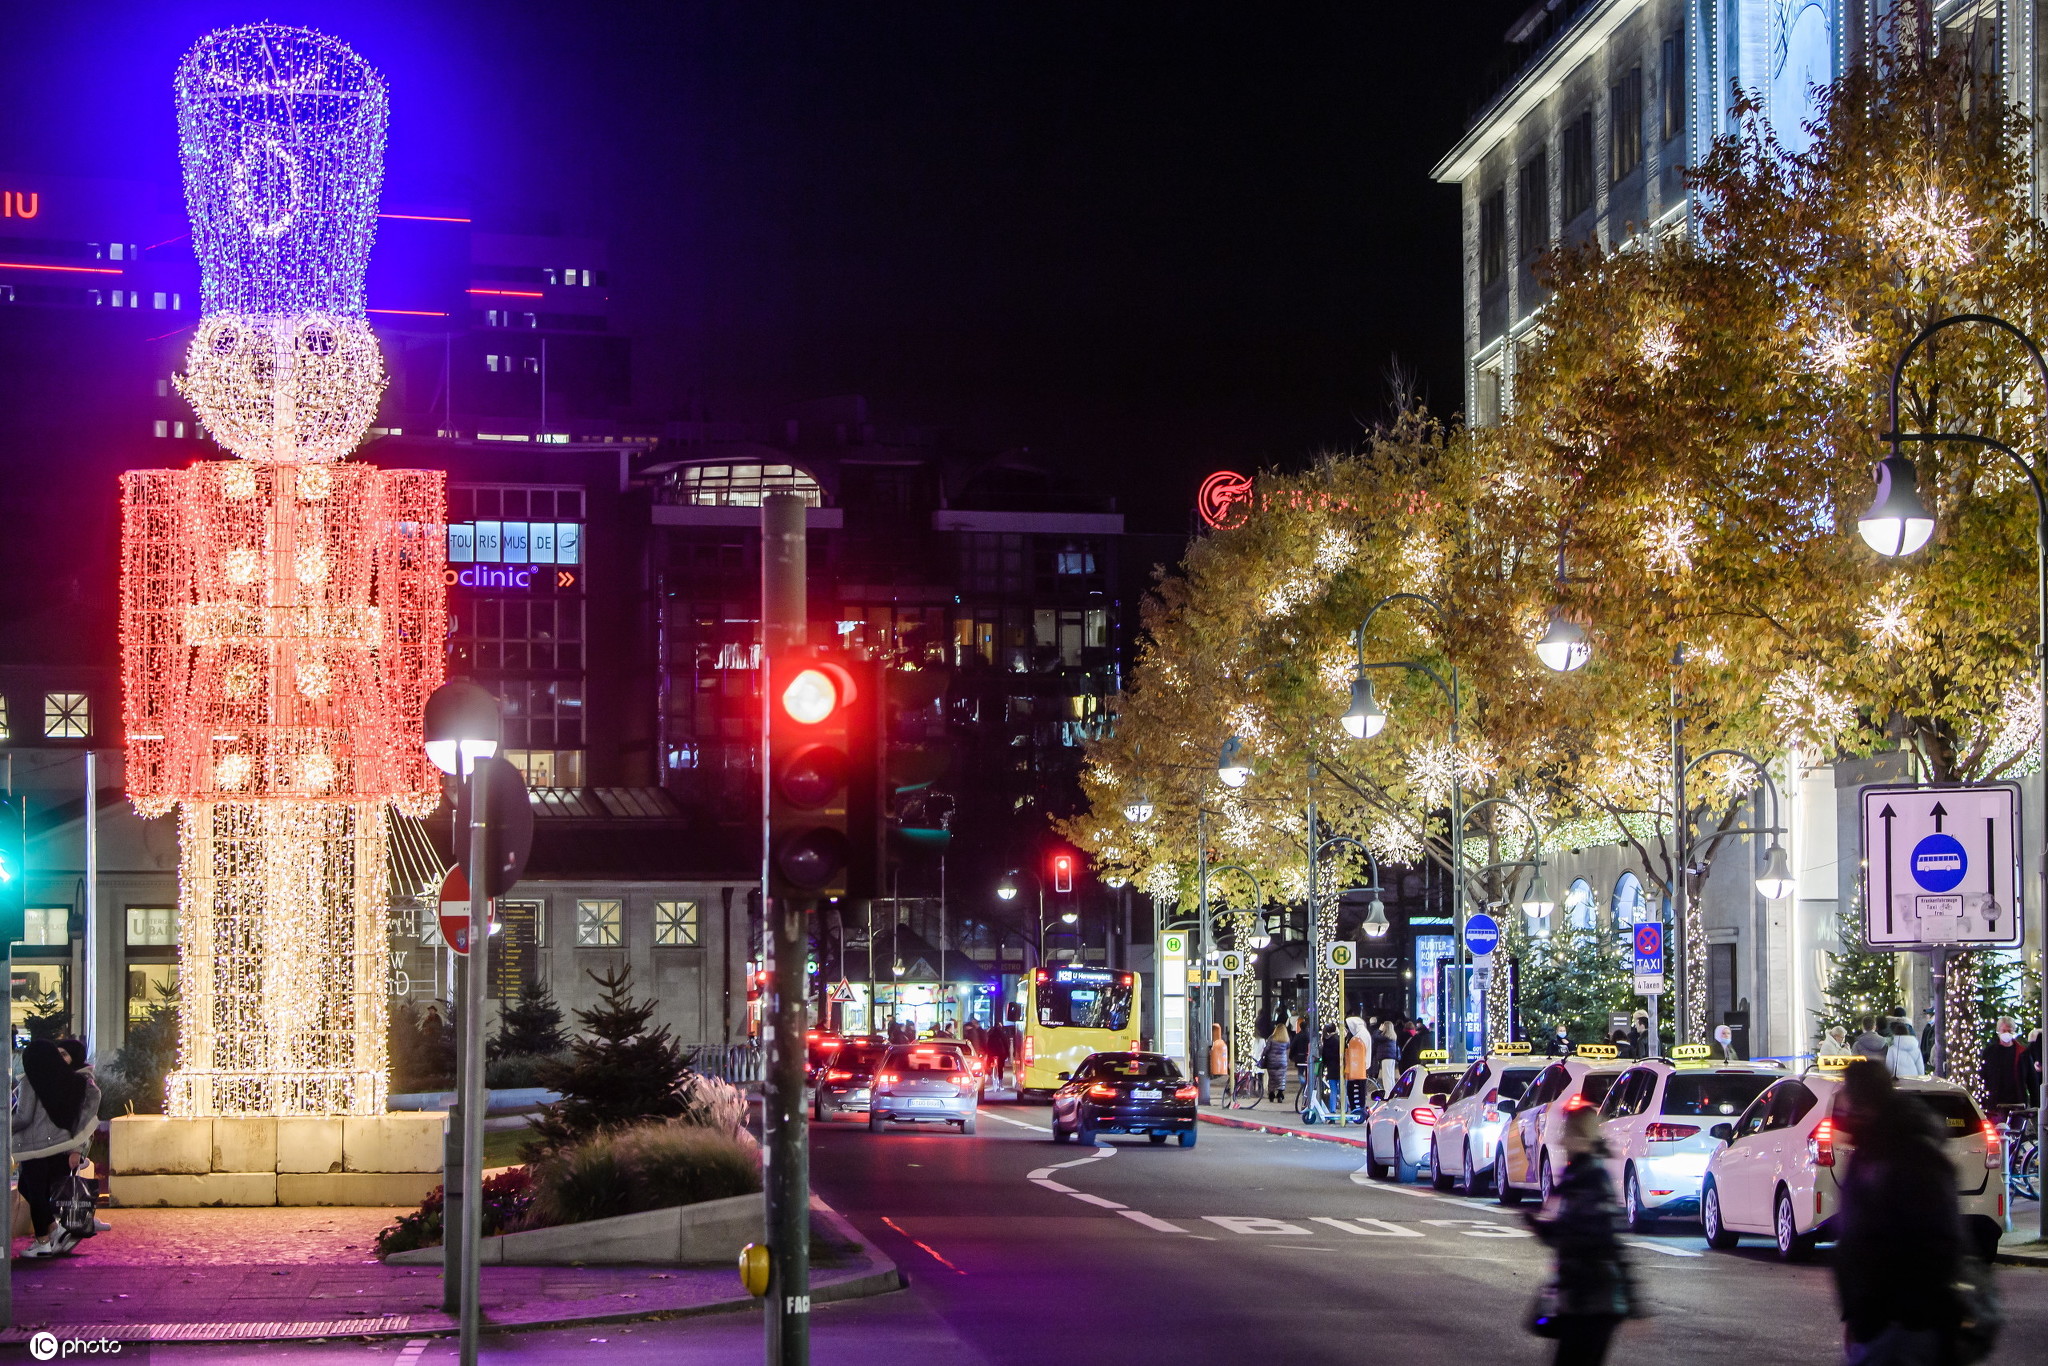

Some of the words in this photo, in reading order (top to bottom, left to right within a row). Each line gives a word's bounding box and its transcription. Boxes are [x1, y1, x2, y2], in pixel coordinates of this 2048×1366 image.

[5, 191, 38, 219] IU
[1636, 958, 1660, 970] TAXI
[1637, 981, 1642, 989] 4
[1643, 981, 1660, 989] Taxen
[1585, 1046, 1612, 1054] TAXI
[1681, 1046, 1705, 1055] TAXI
[1201, 1215, 1537, 1238] BUS
